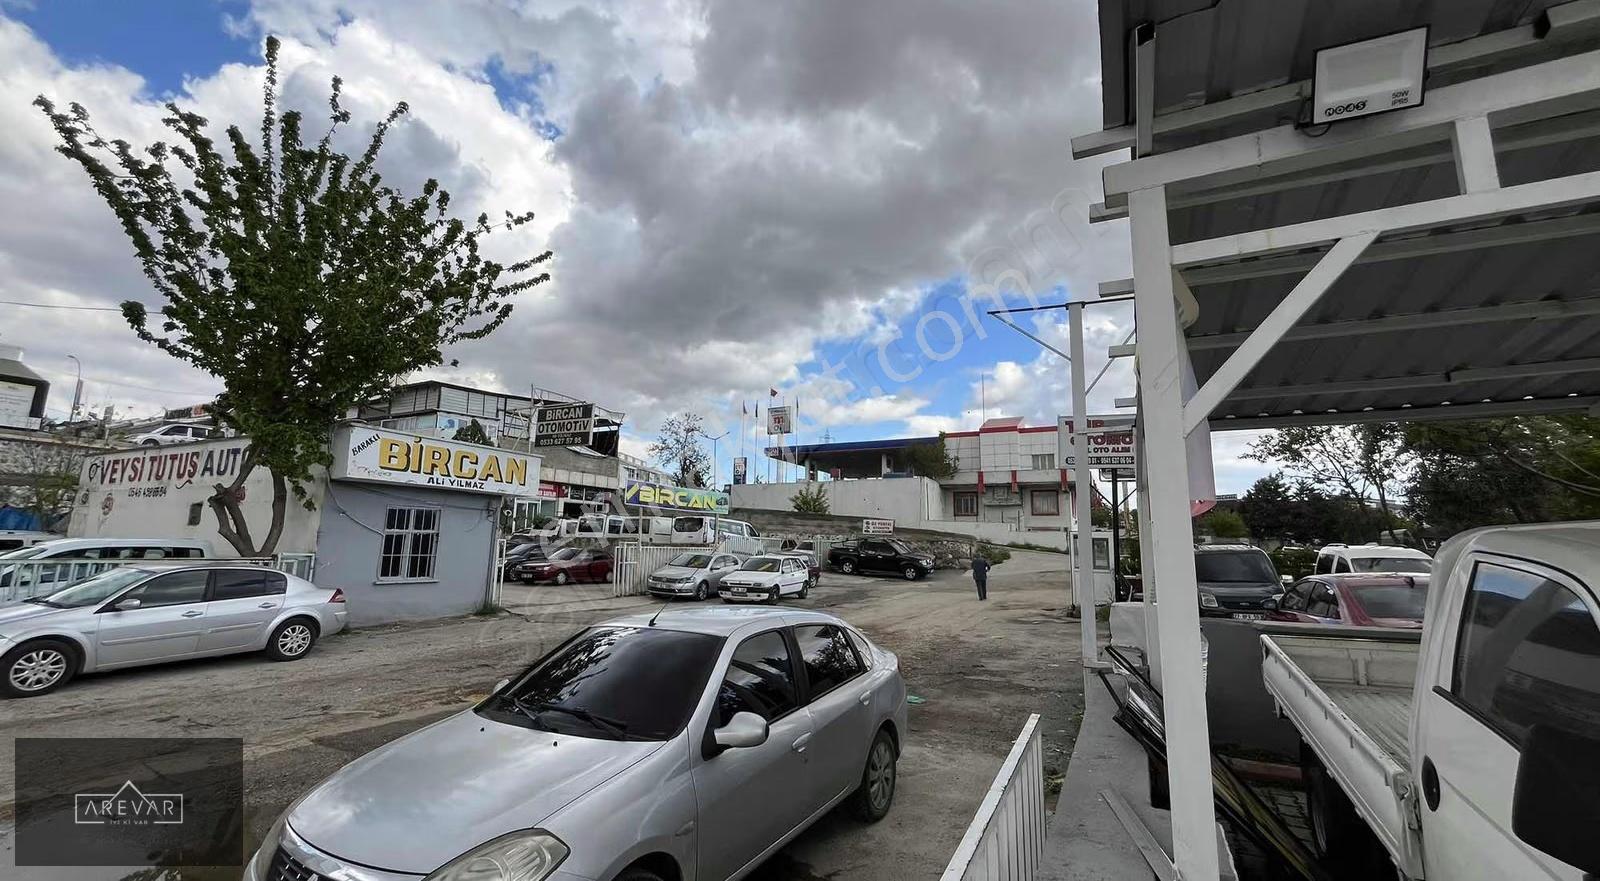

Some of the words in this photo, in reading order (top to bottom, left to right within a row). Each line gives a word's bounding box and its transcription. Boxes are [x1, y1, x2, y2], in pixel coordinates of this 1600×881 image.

[351, 433, 381, 456] BARAKLI
[100, 450, 146, 485] VEYSİ
[377, 436, 528, 487] BİRCAN
[427, 476, 445, 486] ALİ
[448, 478, 485, 490] YILMAZ
[639, 485, 718, 511] BİRCAN
